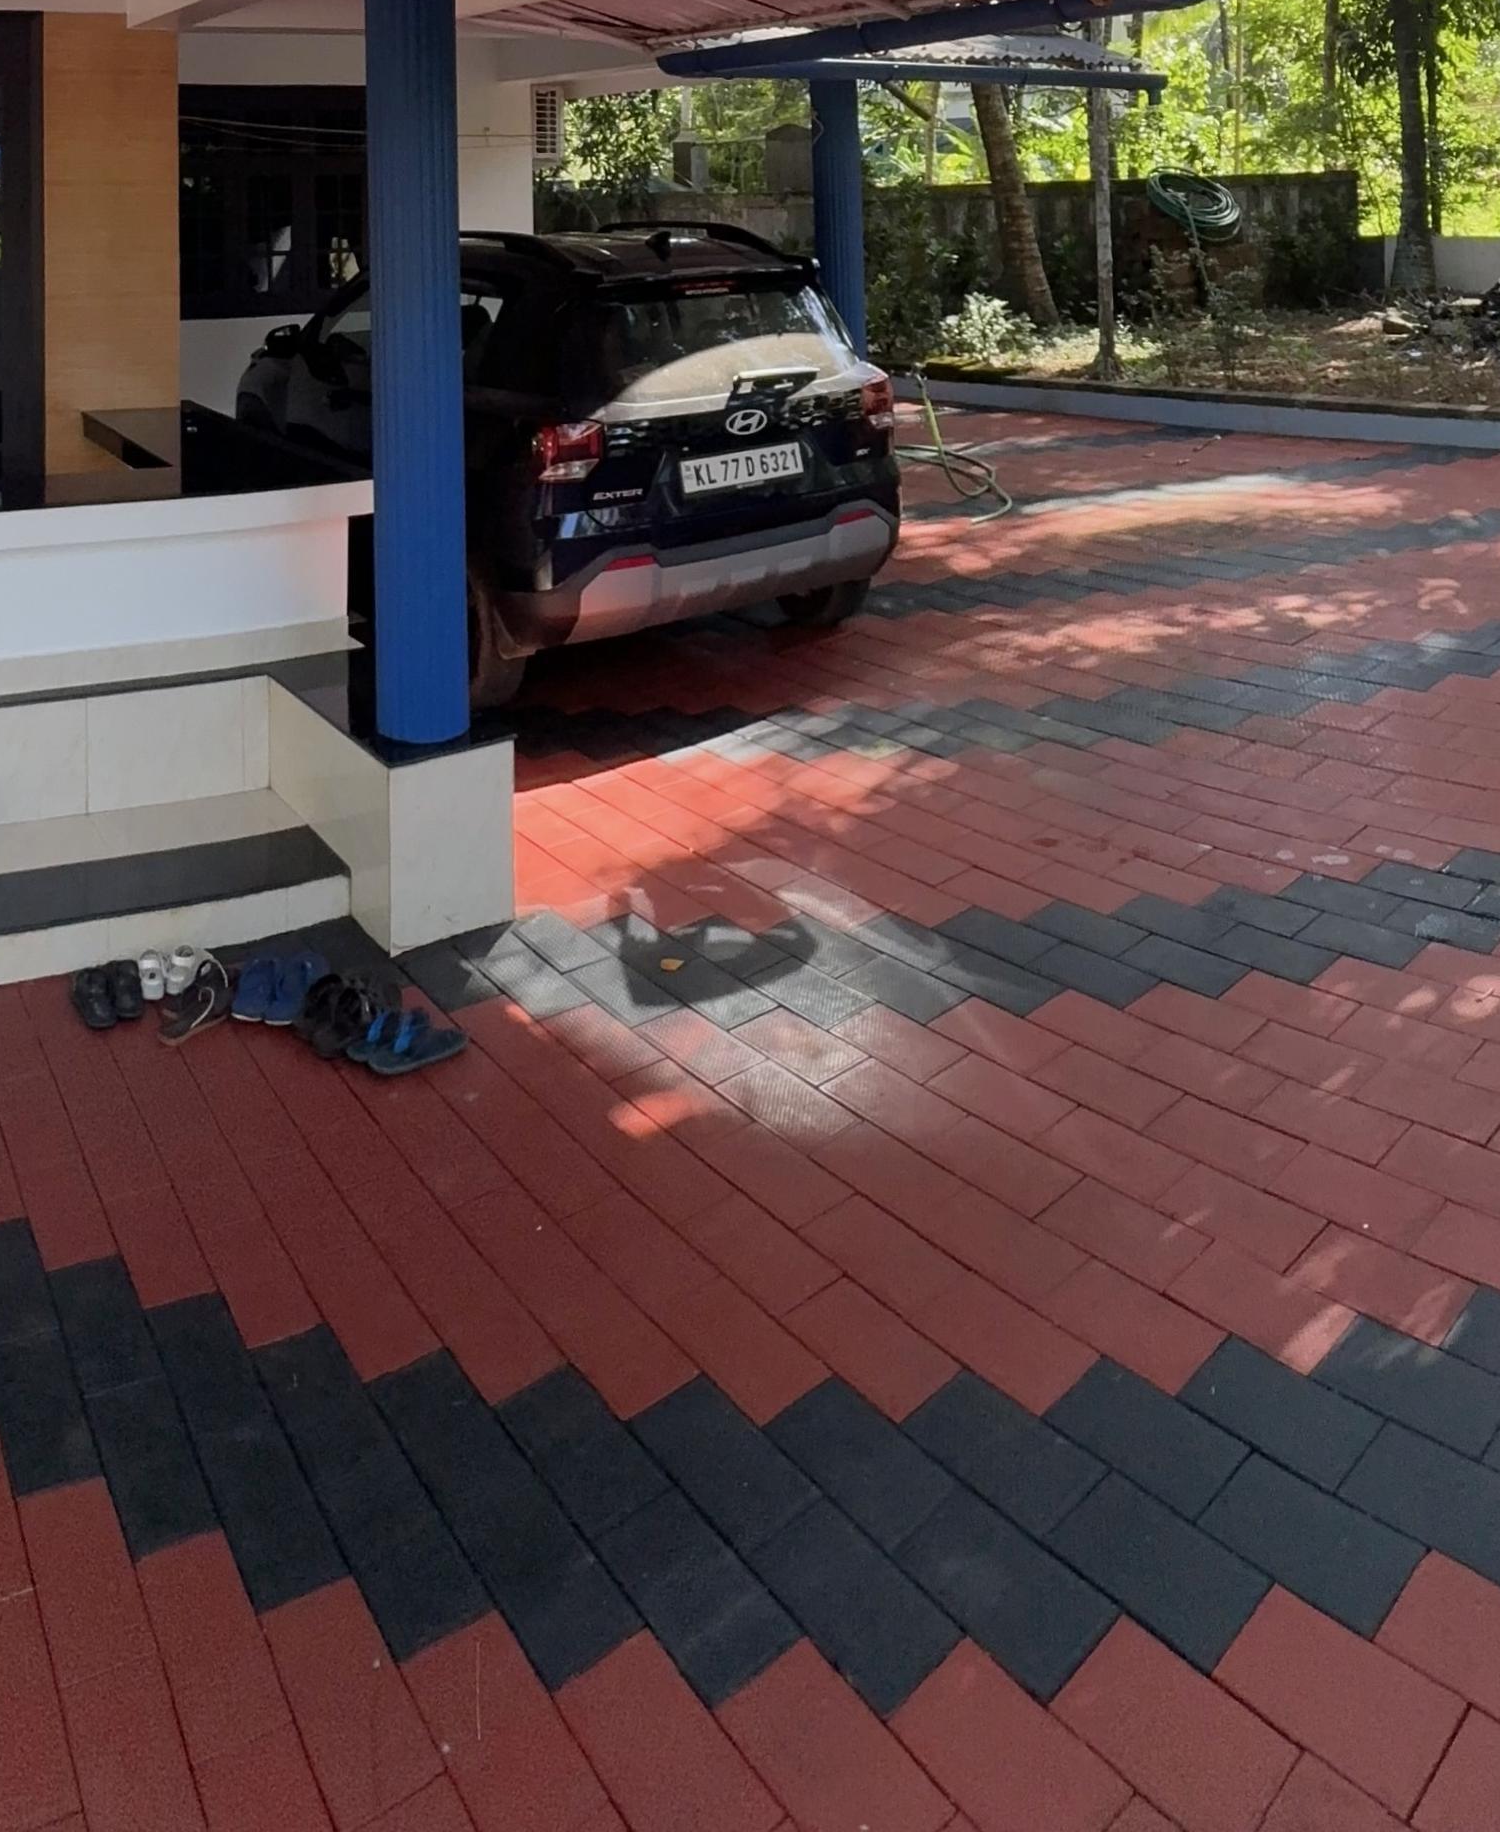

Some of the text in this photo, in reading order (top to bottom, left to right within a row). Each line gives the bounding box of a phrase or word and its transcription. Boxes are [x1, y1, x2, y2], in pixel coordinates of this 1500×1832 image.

[693, 449, 799, 486] KL 77 D 6321
[593, 488, 643, 501] EXTER
